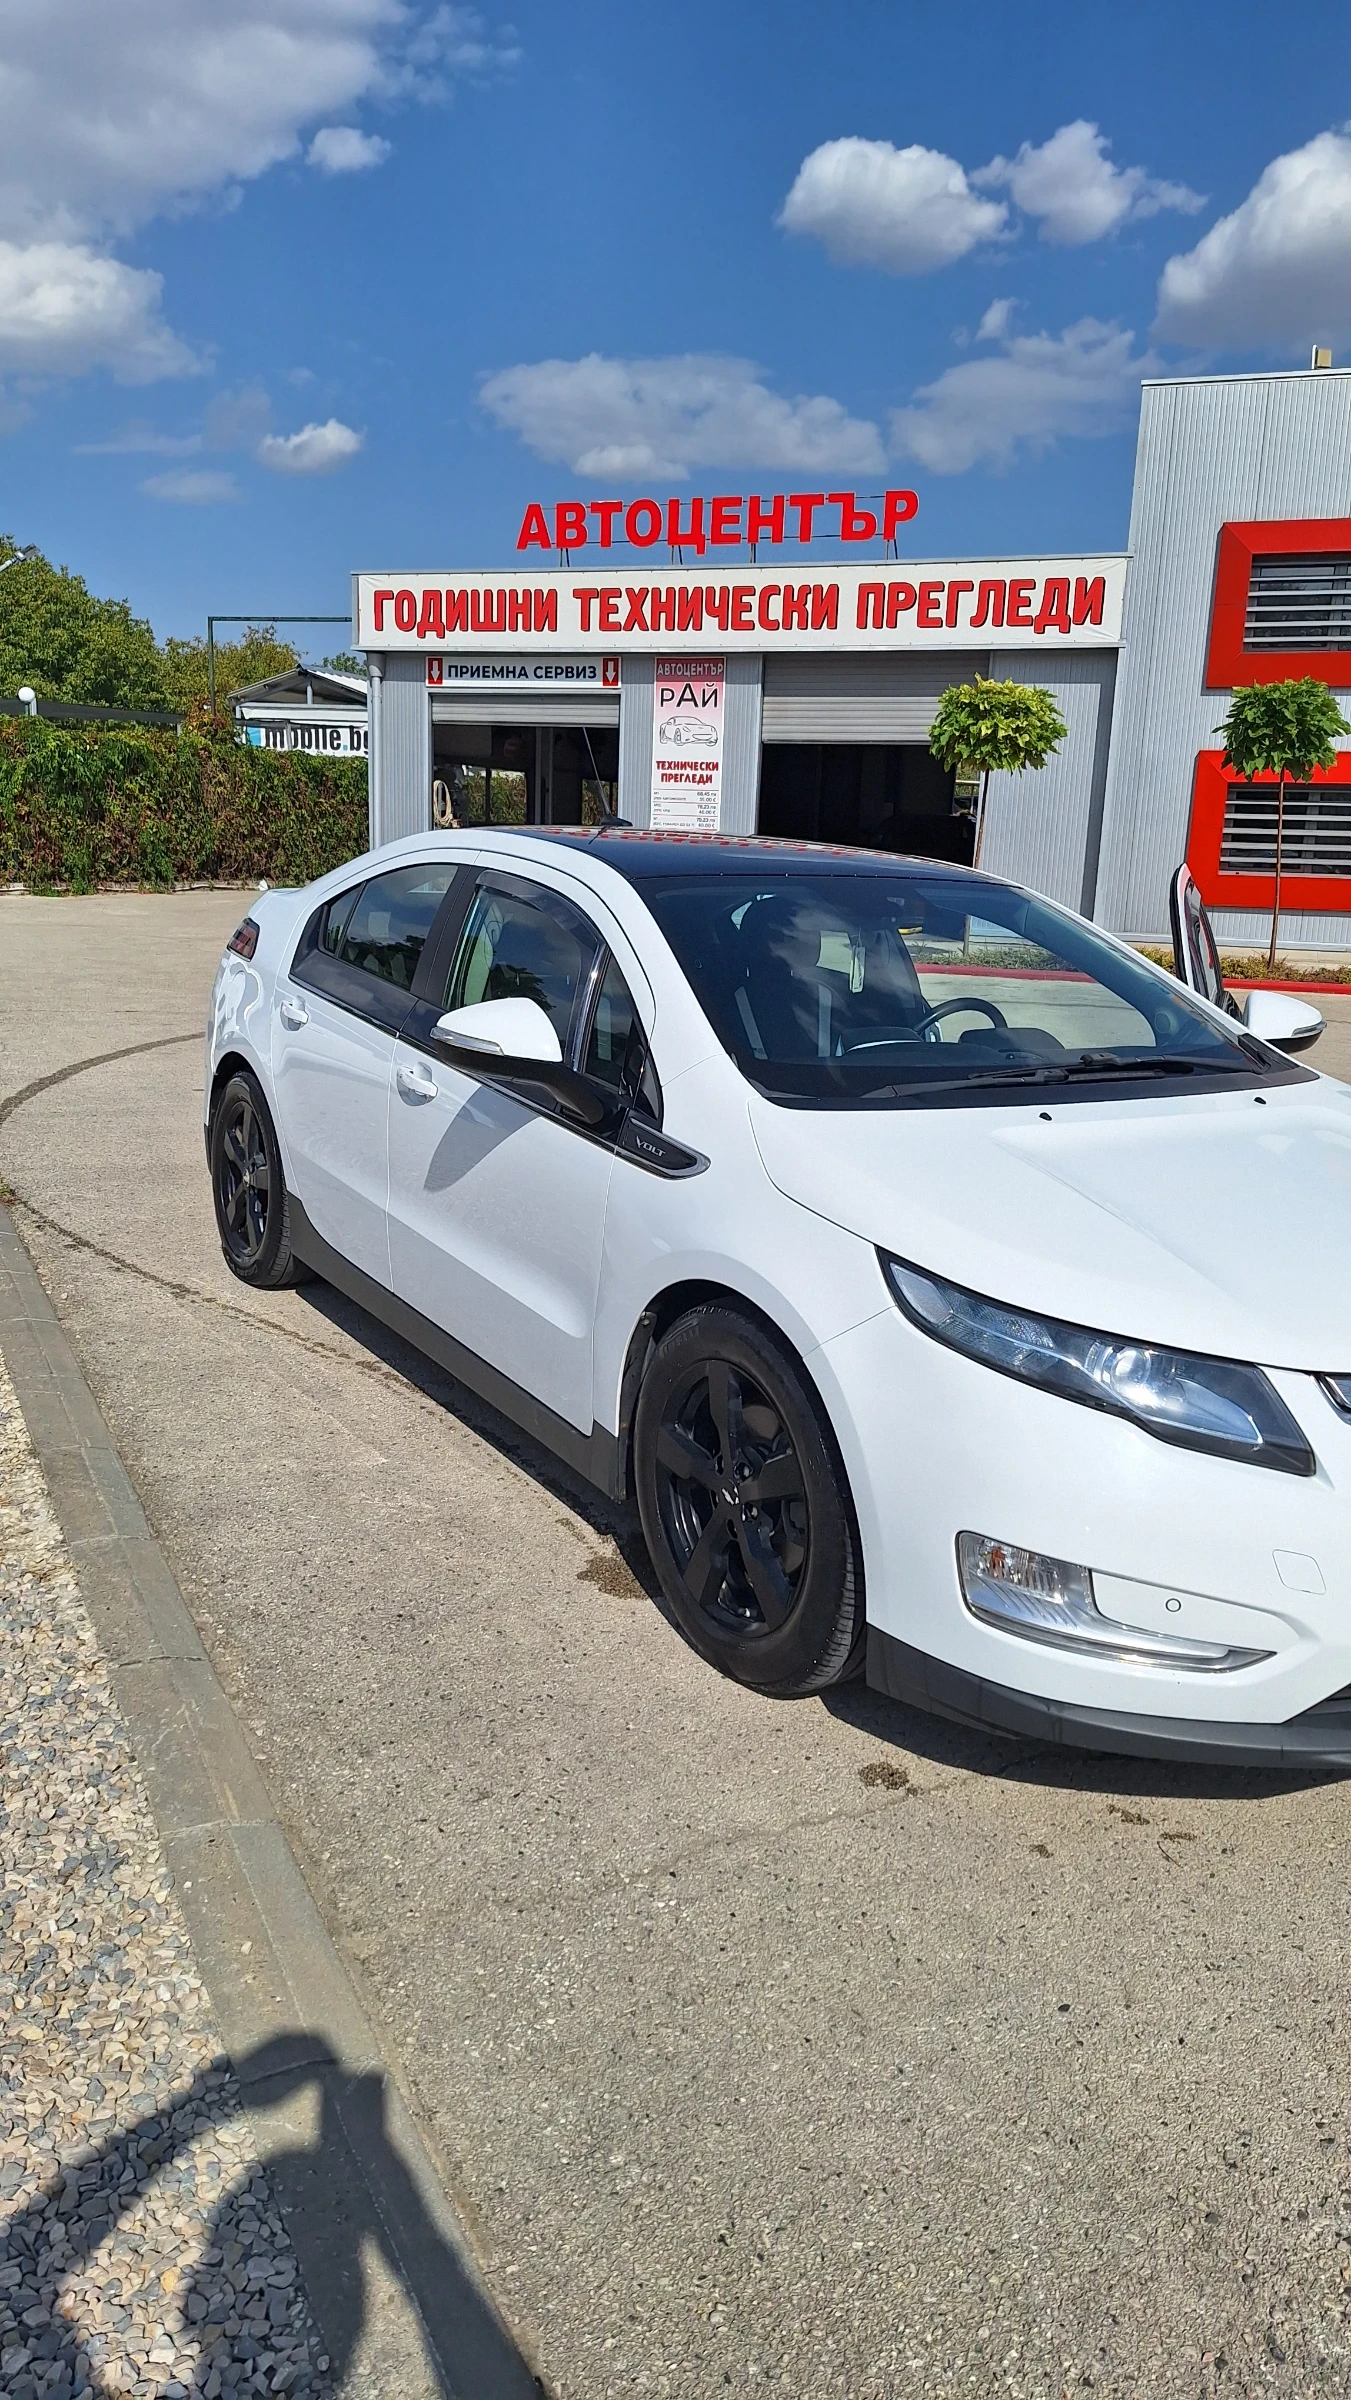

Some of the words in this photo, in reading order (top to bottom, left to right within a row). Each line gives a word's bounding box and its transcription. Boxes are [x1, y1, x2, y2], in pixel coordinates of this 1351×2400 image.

[516, 490, 919, 555] АВТОЦЕНТЪР
[373, 588, 558, 639] ГОДИШНИ
[573, 583, 839, 632] ТЕХНИЧЕСКИ
[856, 577, 1106, 634] ПРЕГЛЕДИ
[448, 664, 529, 679] ПРИЕМНА
[533, 665, 597, 680] СЕРВИЗ
[657, 662, 724, 677] АВТОЦЕНТЪР
[655, 760, 719, 771] ТЕХНИЧЕСКИ
[661, 773, 713, 785] ПРЕГЛЕДИ
[635, 1135, 666, 1157] VOLT
